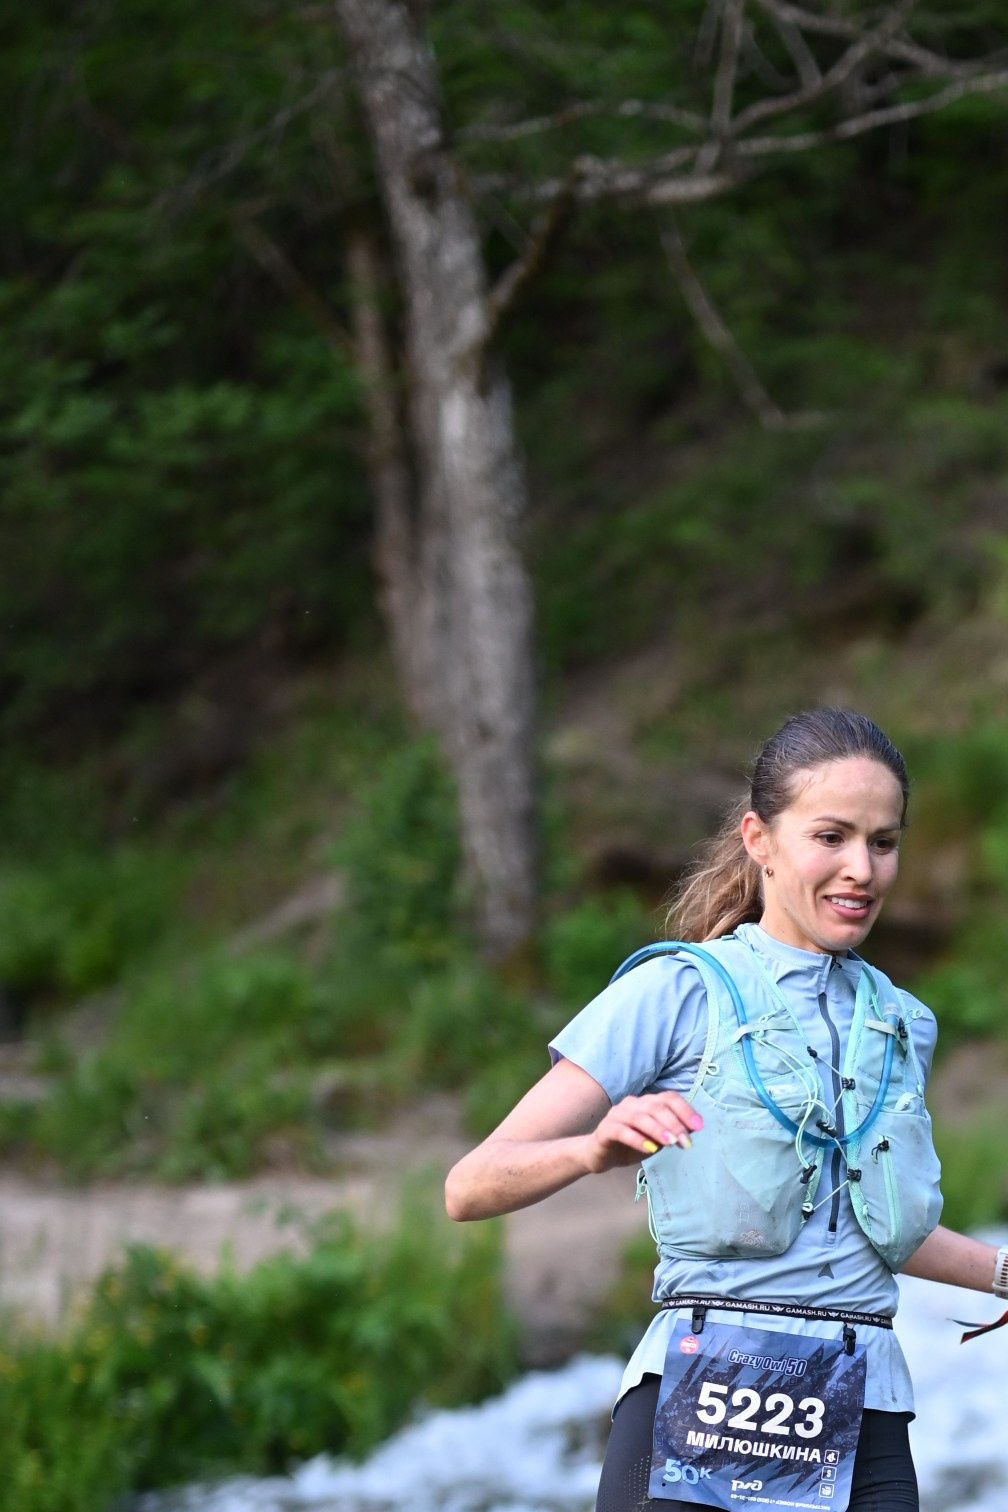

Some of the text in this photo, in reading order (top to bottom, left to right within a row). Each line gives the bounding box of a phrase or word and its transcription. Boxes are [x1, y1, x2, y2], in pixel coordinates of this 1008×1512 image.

[725, 1301, 770, 1311] GAMASH.RU
[785, 1308, 827, 1317] GAMASH.RU
[728, 1348, 807, 1377] Crazy Owl 50
[696, 1381, 826, 1439] 5223
[686, 1430, 821, 1463] МИЛЮШКИНА
